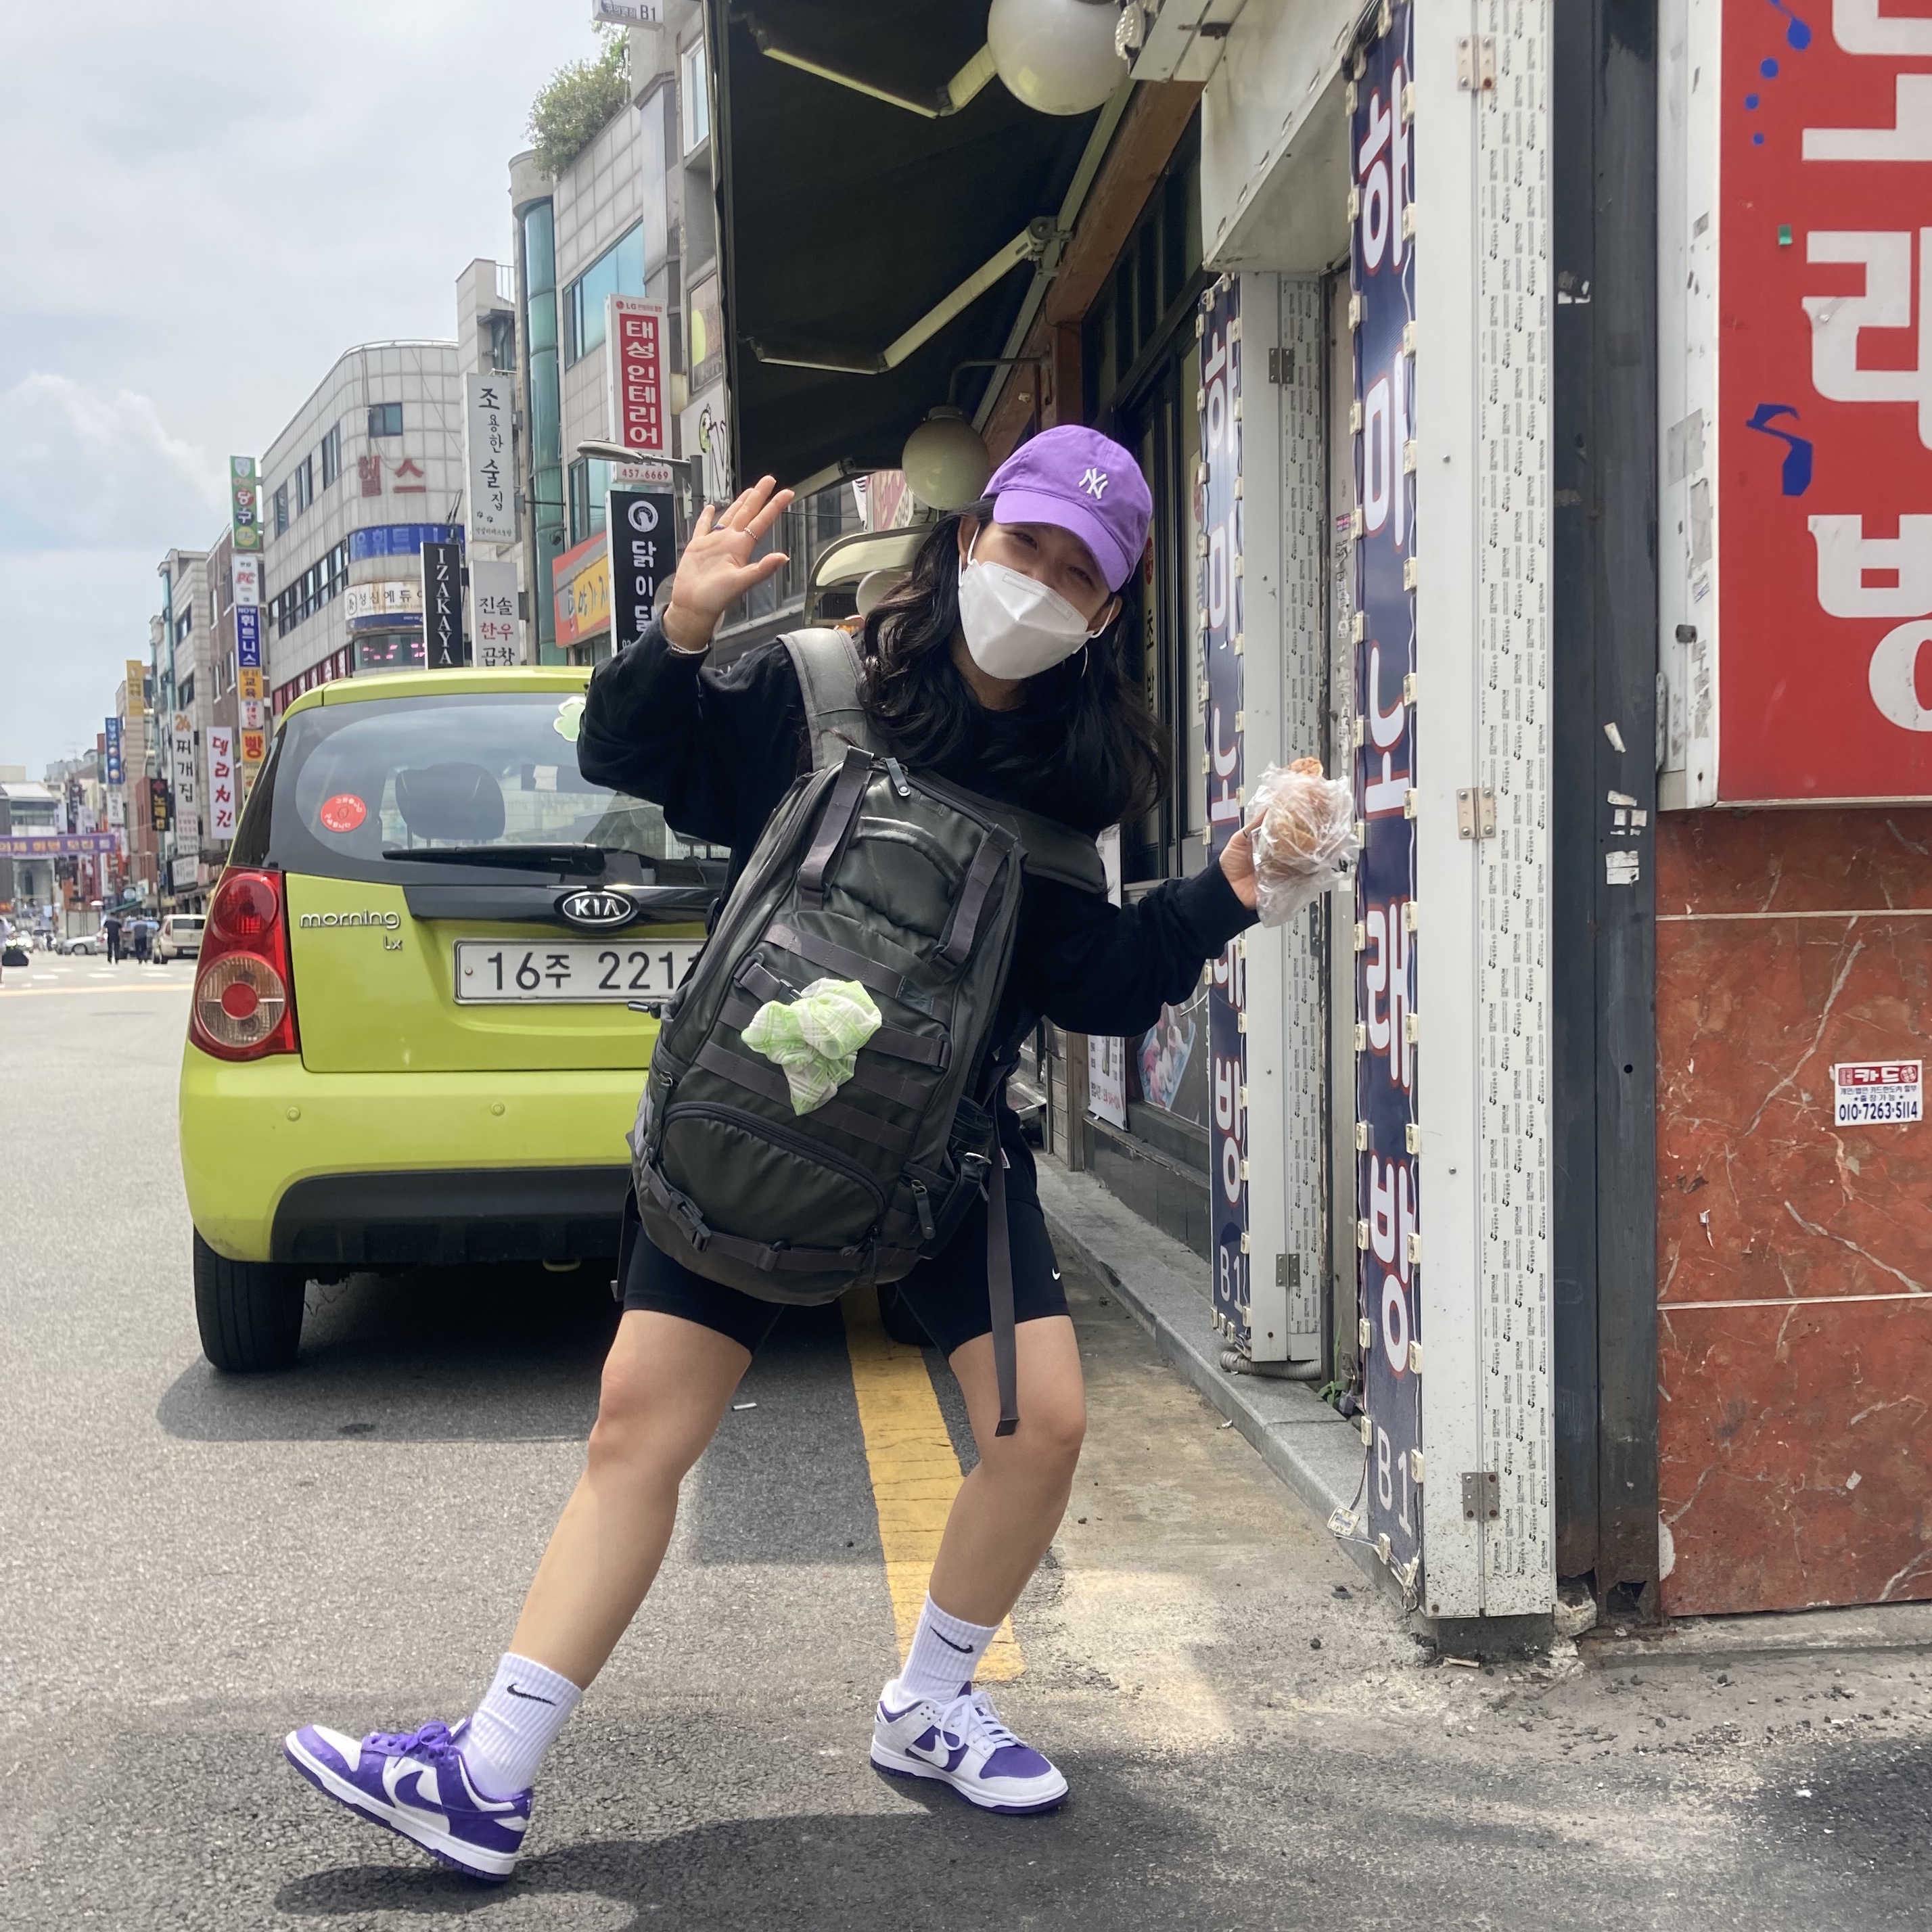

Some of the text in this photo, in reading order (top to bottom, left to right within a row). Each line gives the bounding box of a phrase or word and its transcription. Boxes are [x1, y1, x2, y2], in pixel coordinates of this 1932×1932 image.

[640, 4, 656, 21] B1
[626, 321, 655, 359] 태성
[627, 365, 658, 444] 인테리어
[358, 455, 426, 497] 헬스
[622, 468, 669, 481] 457-6669
[1078, 467, 1109, 500] NY
[236, 572, 256, 584] PC
[436, 548, 453, 665] IZAKAYA
[479, 596, 513, 616] 진솔
[480, 622, 514, 641] 한우
[175, 714, 191, 732] 24
[245, 735, 262, 759] 빵
[176, 739, 193, 803] 찌개집
[212, 736, 233, 828] 델리치킨
[300, 908, 401, 929] morning
[574, 898, 621, 917] KIA
[487, 951, 699, 990] 16주 221
[1854, 1067, 1900, 1083] 카드
[1220, 1245, 1243, 1314] B1
[1377, 1427, 1413, 1538] B1
